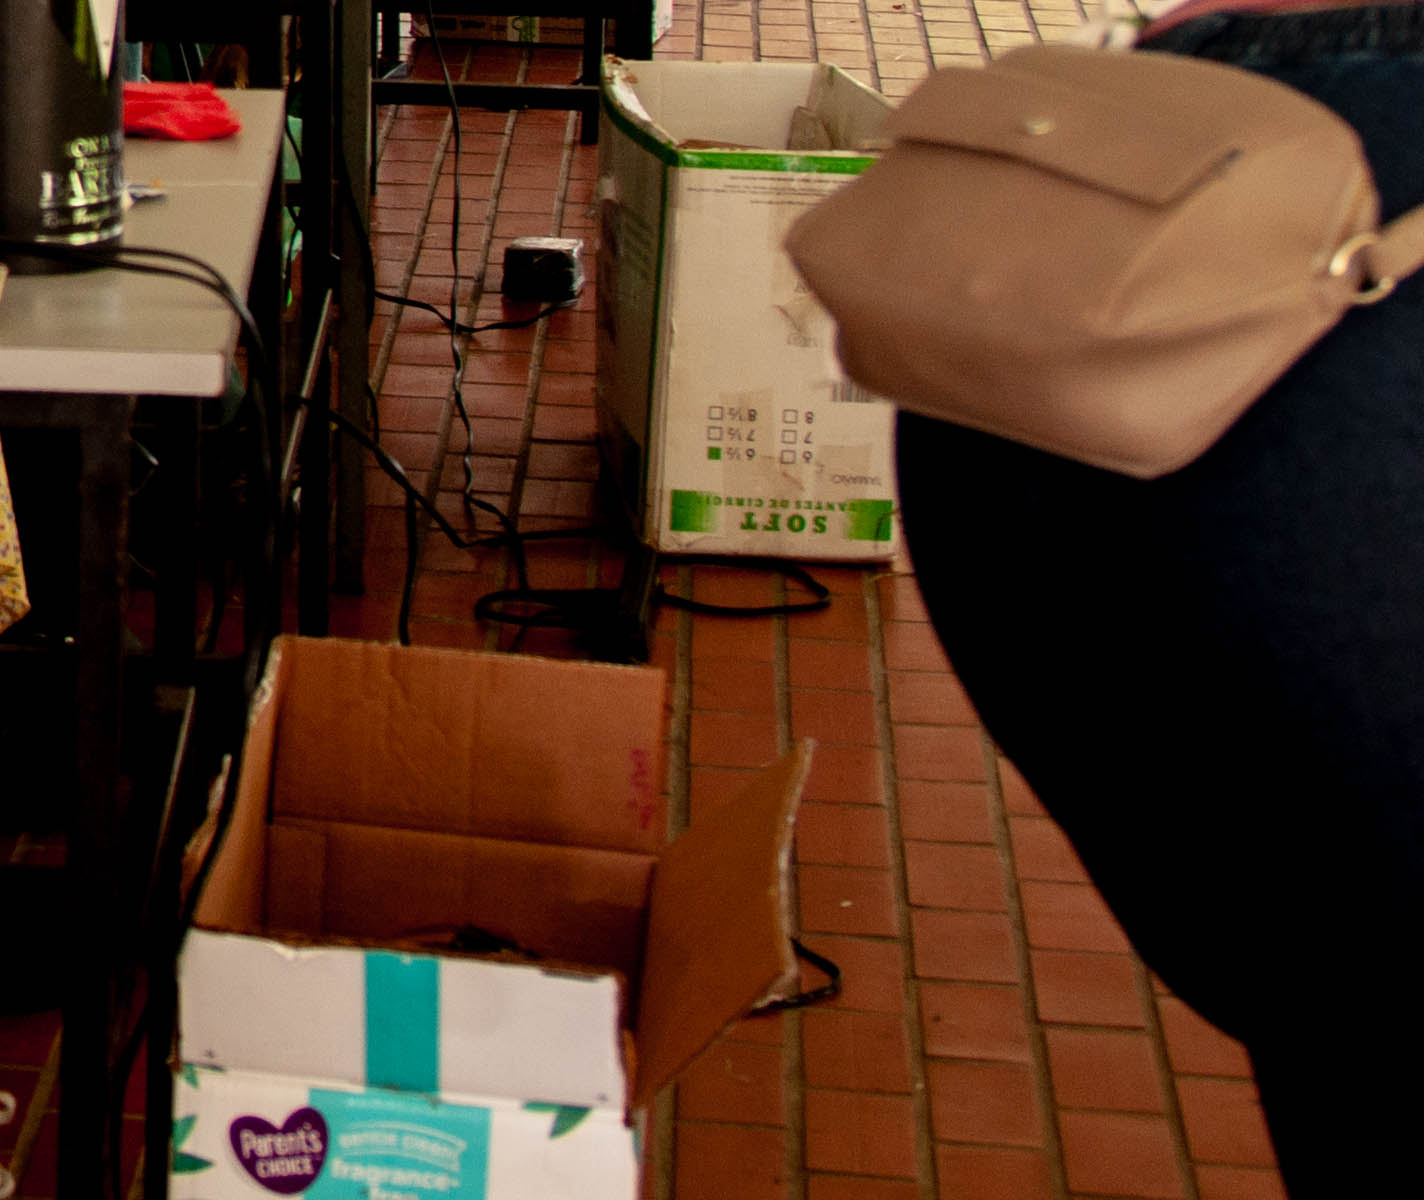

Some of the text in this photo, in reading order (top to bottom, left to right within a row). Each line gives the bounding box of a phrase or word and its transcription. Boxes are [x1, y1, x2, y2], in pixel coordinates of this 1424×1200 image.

[804, 411, 814, 425] 8
[803, 432, 814, 444] 7
[801, 450, 814, 464] 6
[769, 498, 789, 509] DE
[740, 512, 828, 534] SOFT
[239, 1122, 323, 1160] Parent's
[255, 1158, 315, 1179] CHOICE
